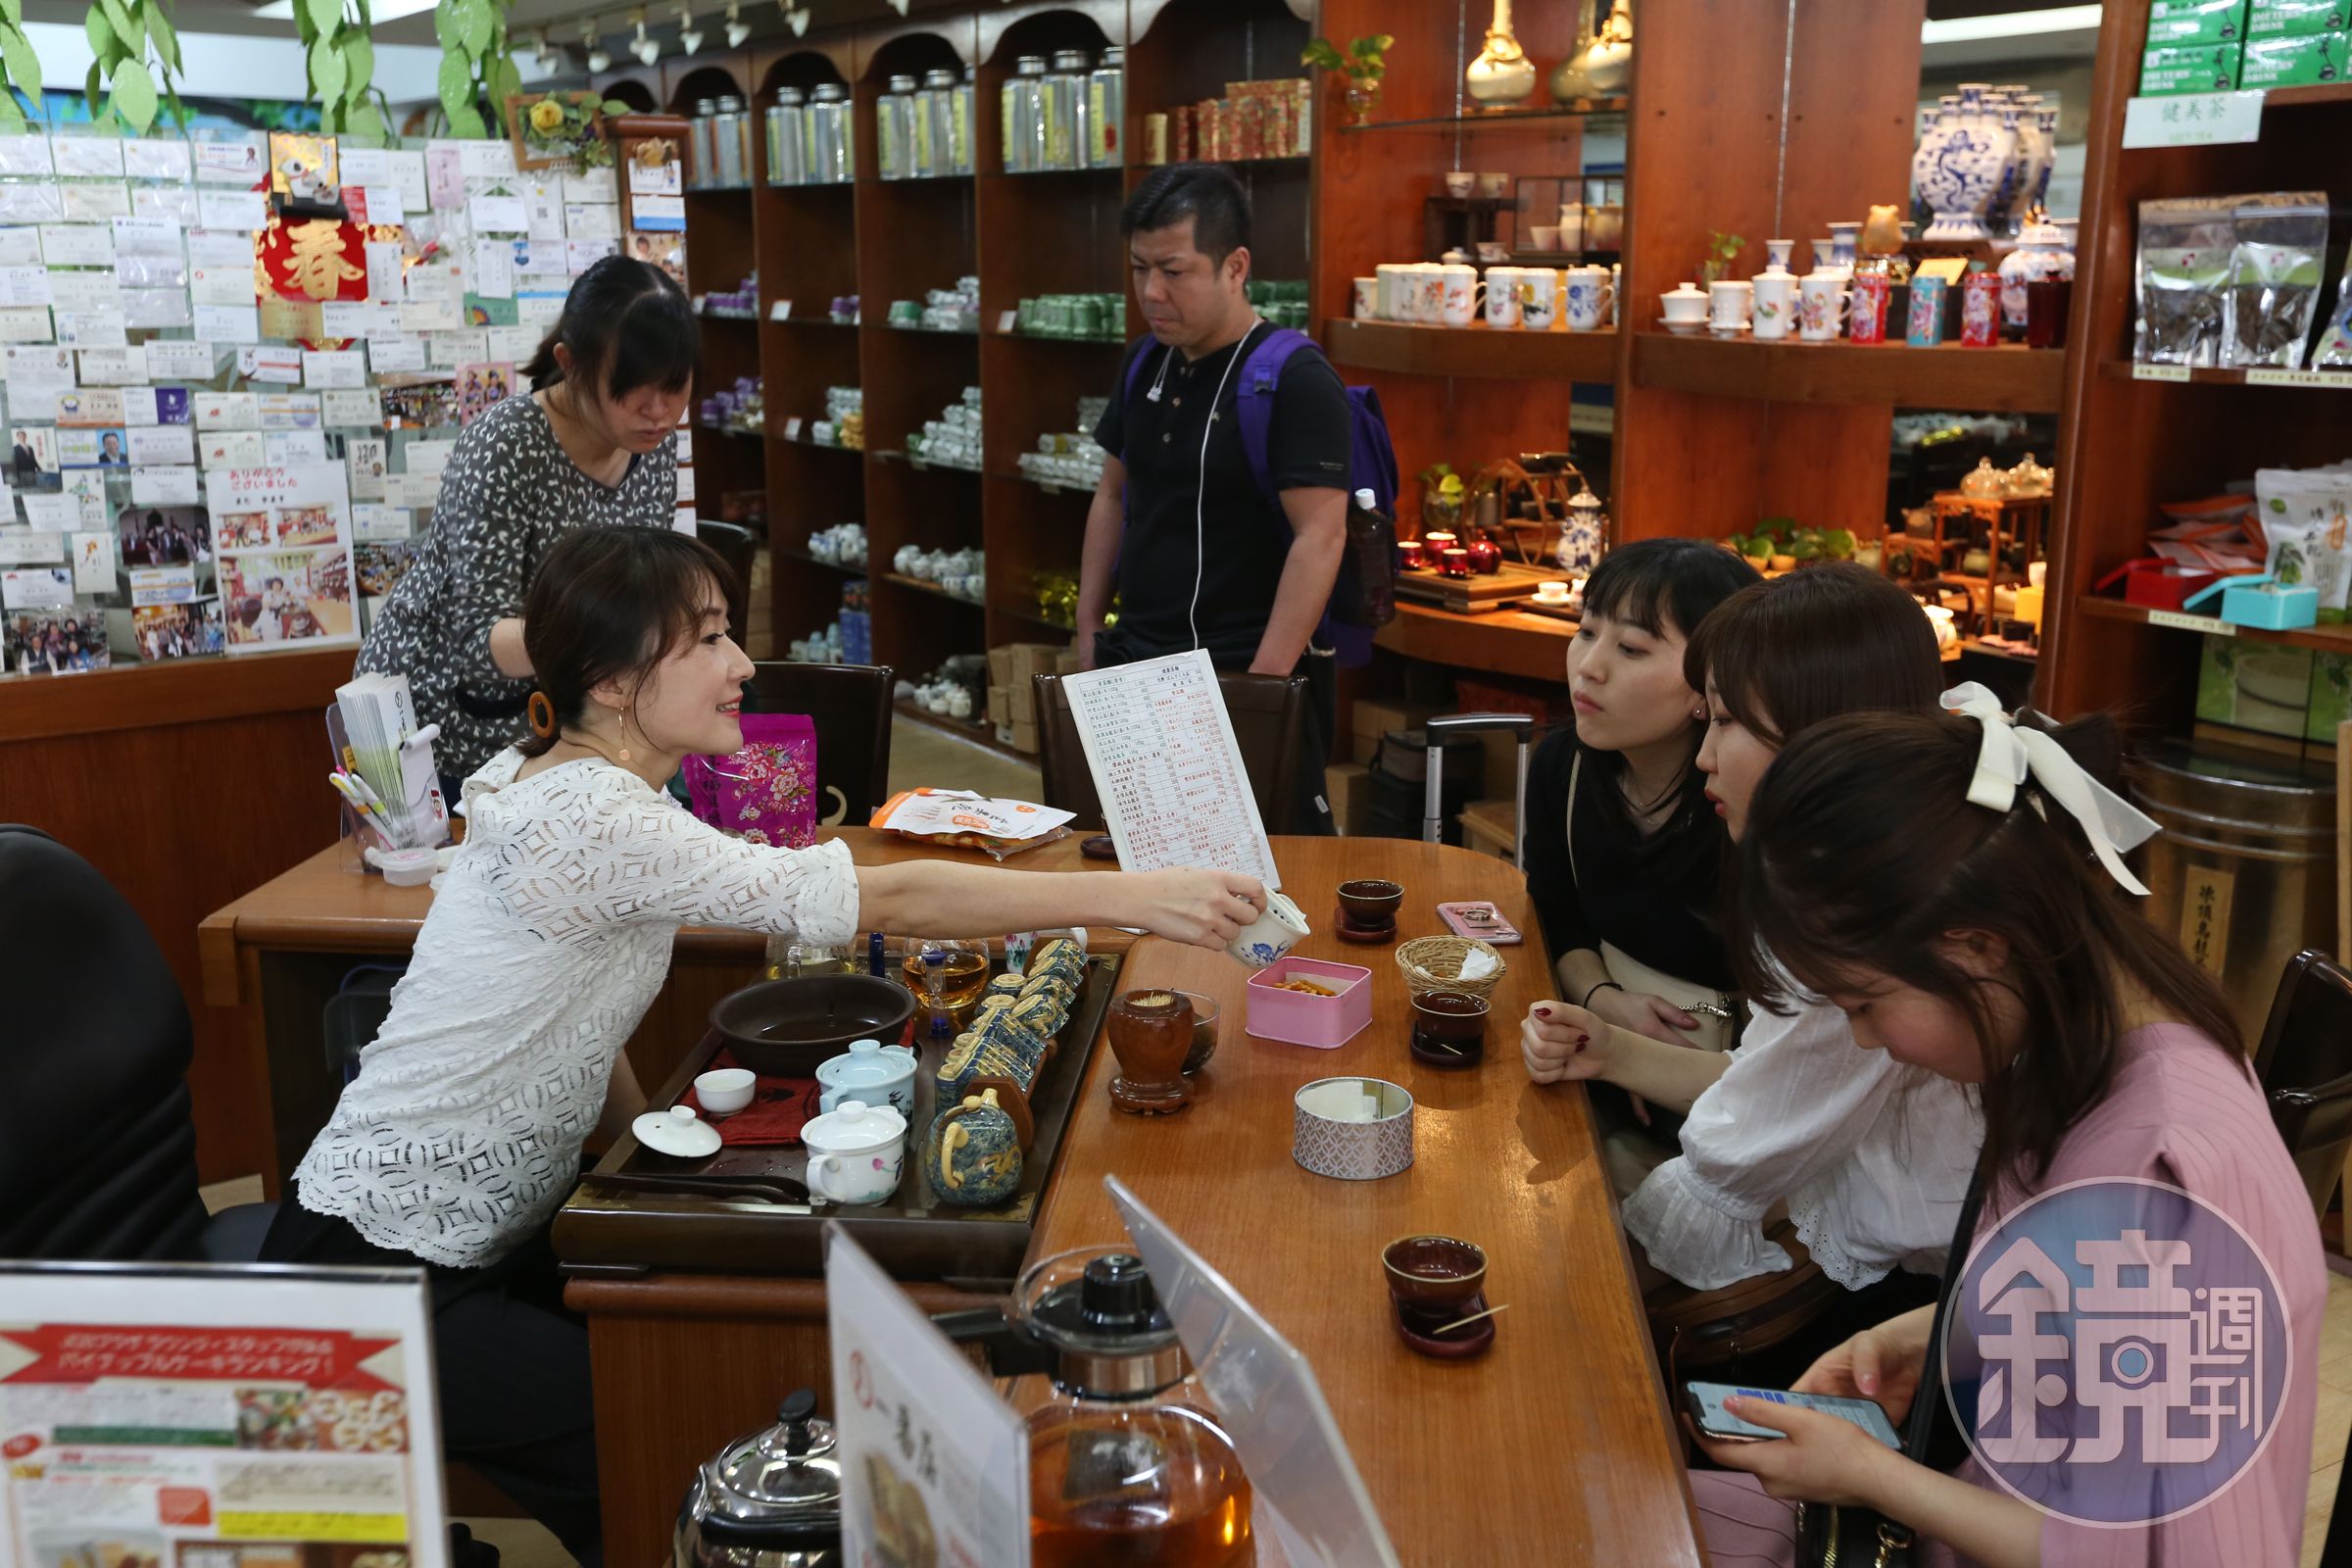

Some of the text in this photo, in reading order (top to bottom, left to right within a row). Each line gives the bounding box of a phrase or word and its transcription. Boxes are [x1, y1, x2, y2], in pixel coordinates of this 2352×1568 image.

[2162, 96, 2227, 123] 健美茶
[283, 219, 365, 299] 春
